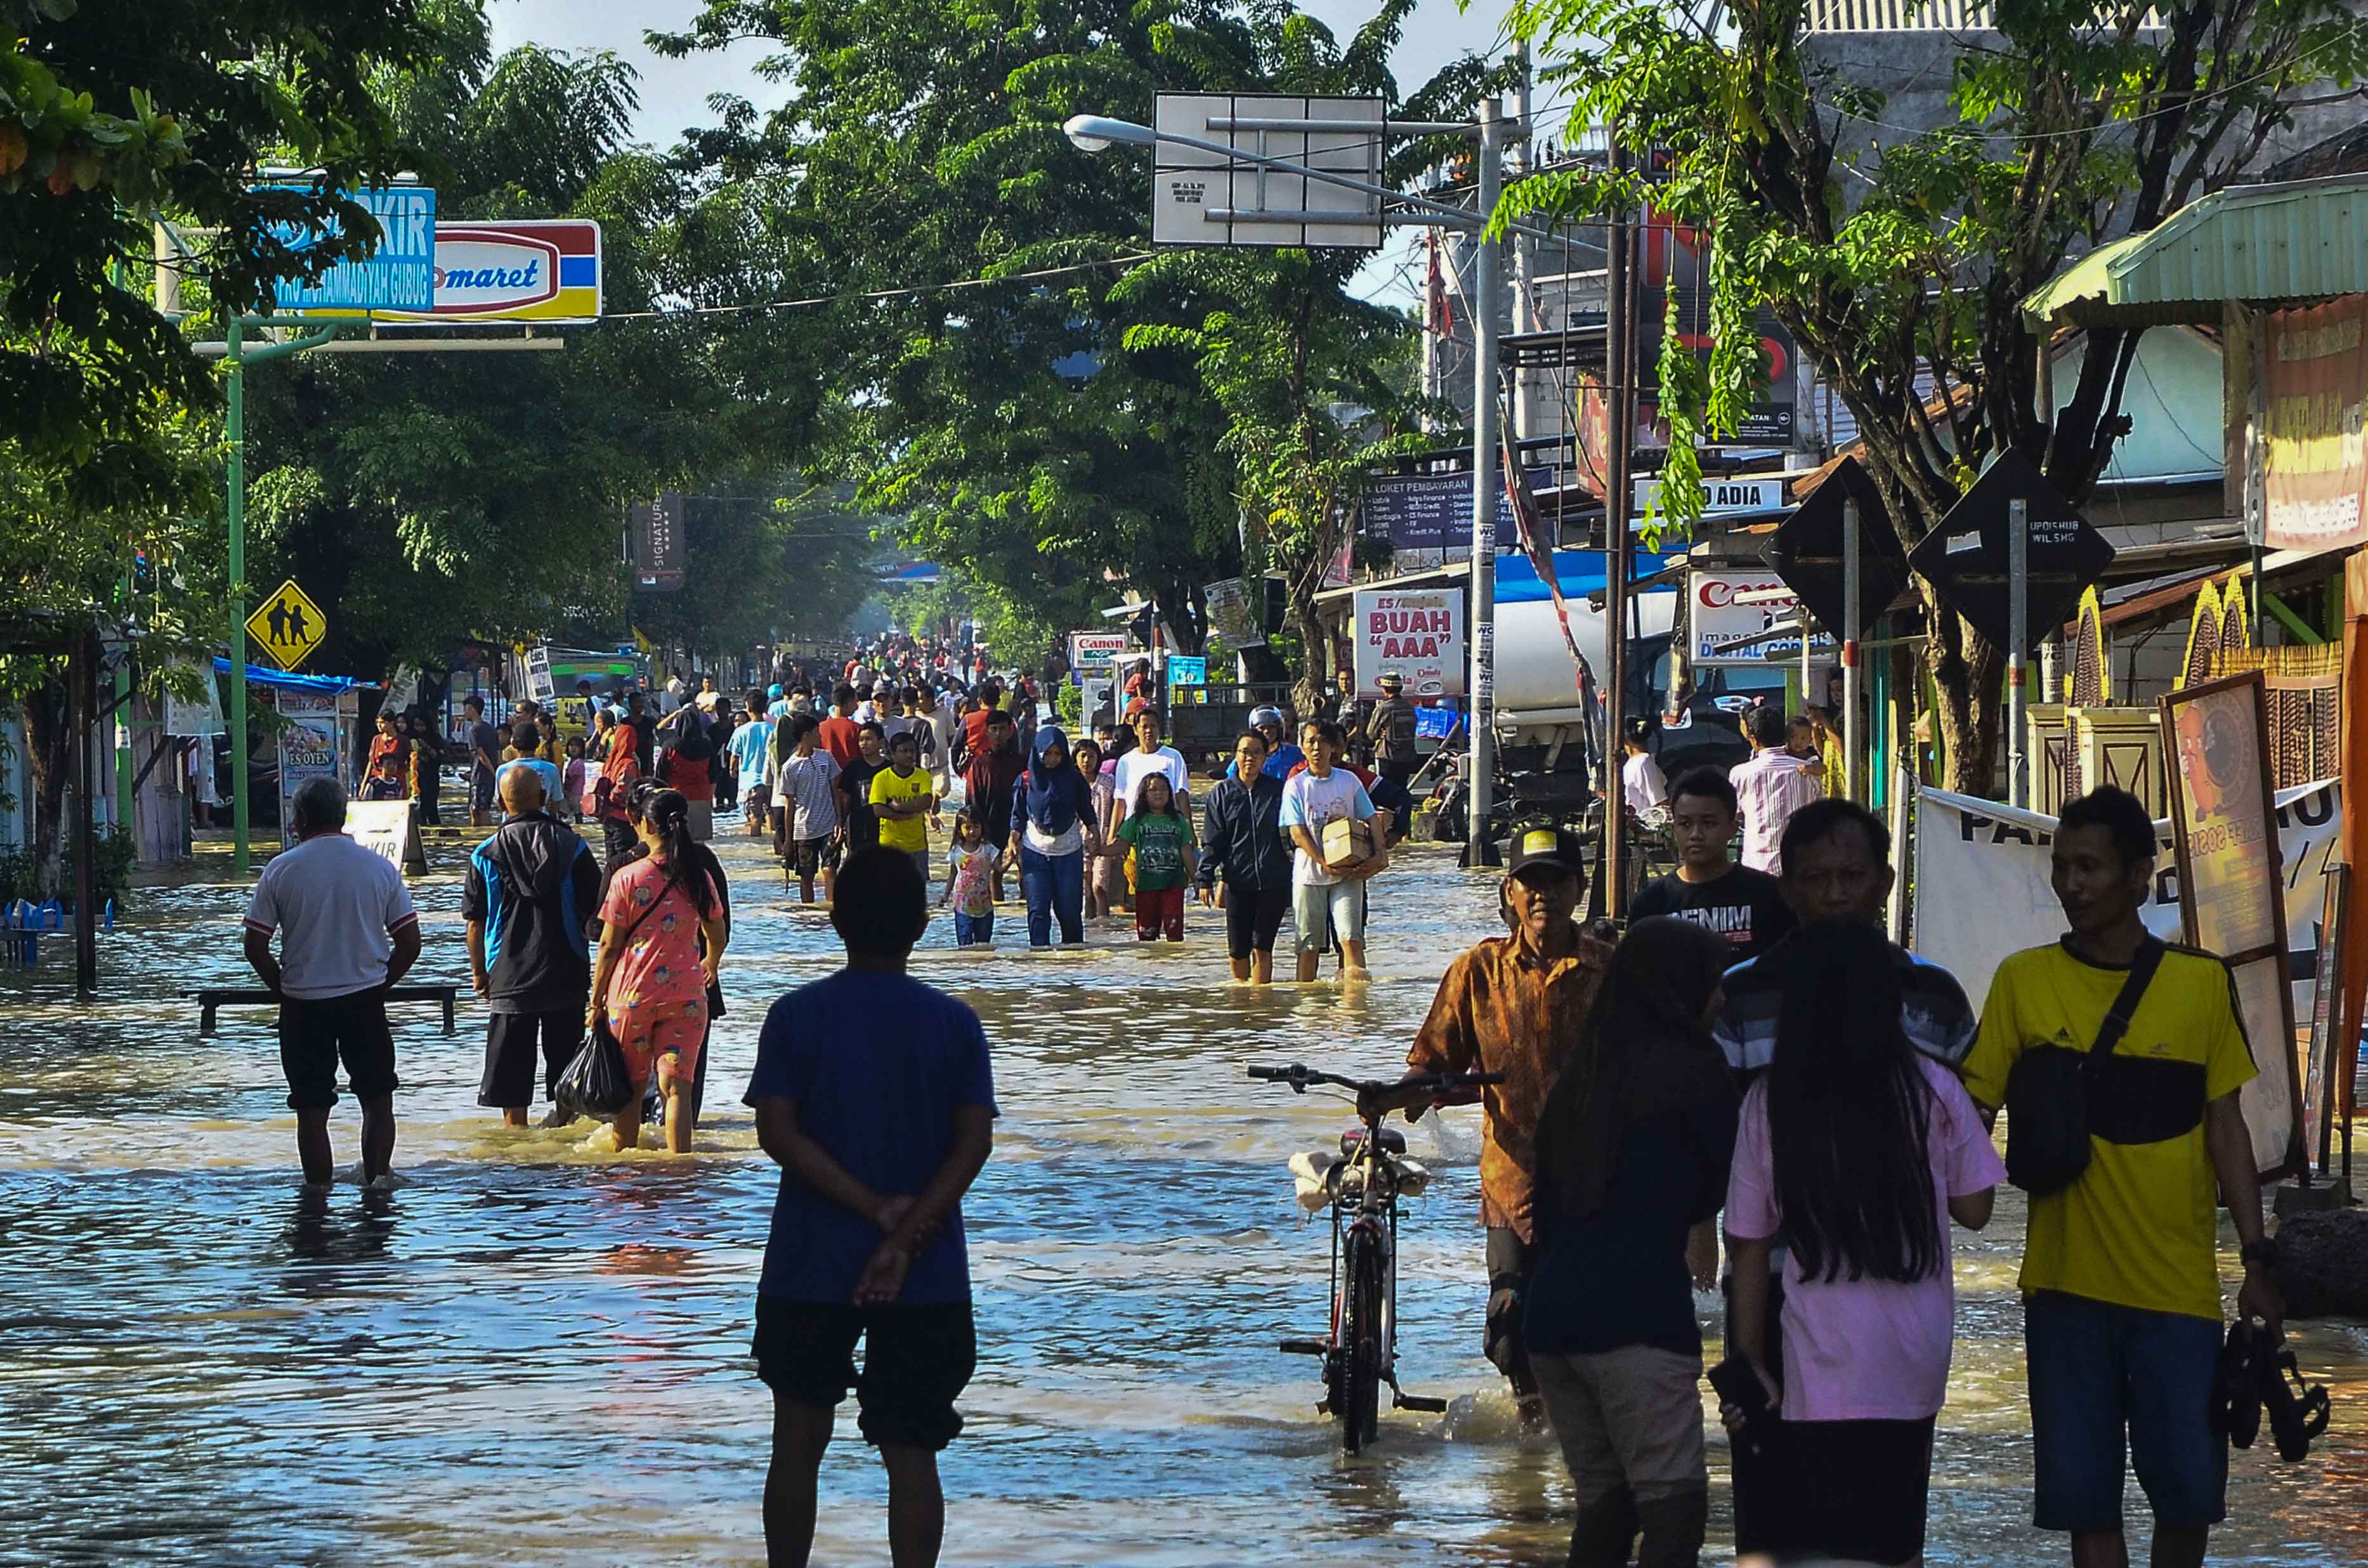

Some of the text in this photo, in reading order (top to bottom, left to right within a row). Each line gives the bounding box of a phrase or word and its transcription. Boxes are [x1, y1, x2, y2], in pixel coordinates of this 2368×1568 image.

[390, 263, 427, 305] GUBUG
[1376, 480, 1468, 493] LOKET PEMBAYARAN
[1717, 486, 1762, 505] ADIA
[652, 497, 664, 566] SIGNATURE
[1699, 581, 1796, 608] Can
[1370, 610, 1451, 634] BUAH
[1078, 638, 1123, 649] Canon
[289, 752, 330, 765] ES OYEN
[1667, 905, 1751, 932] ENIM
